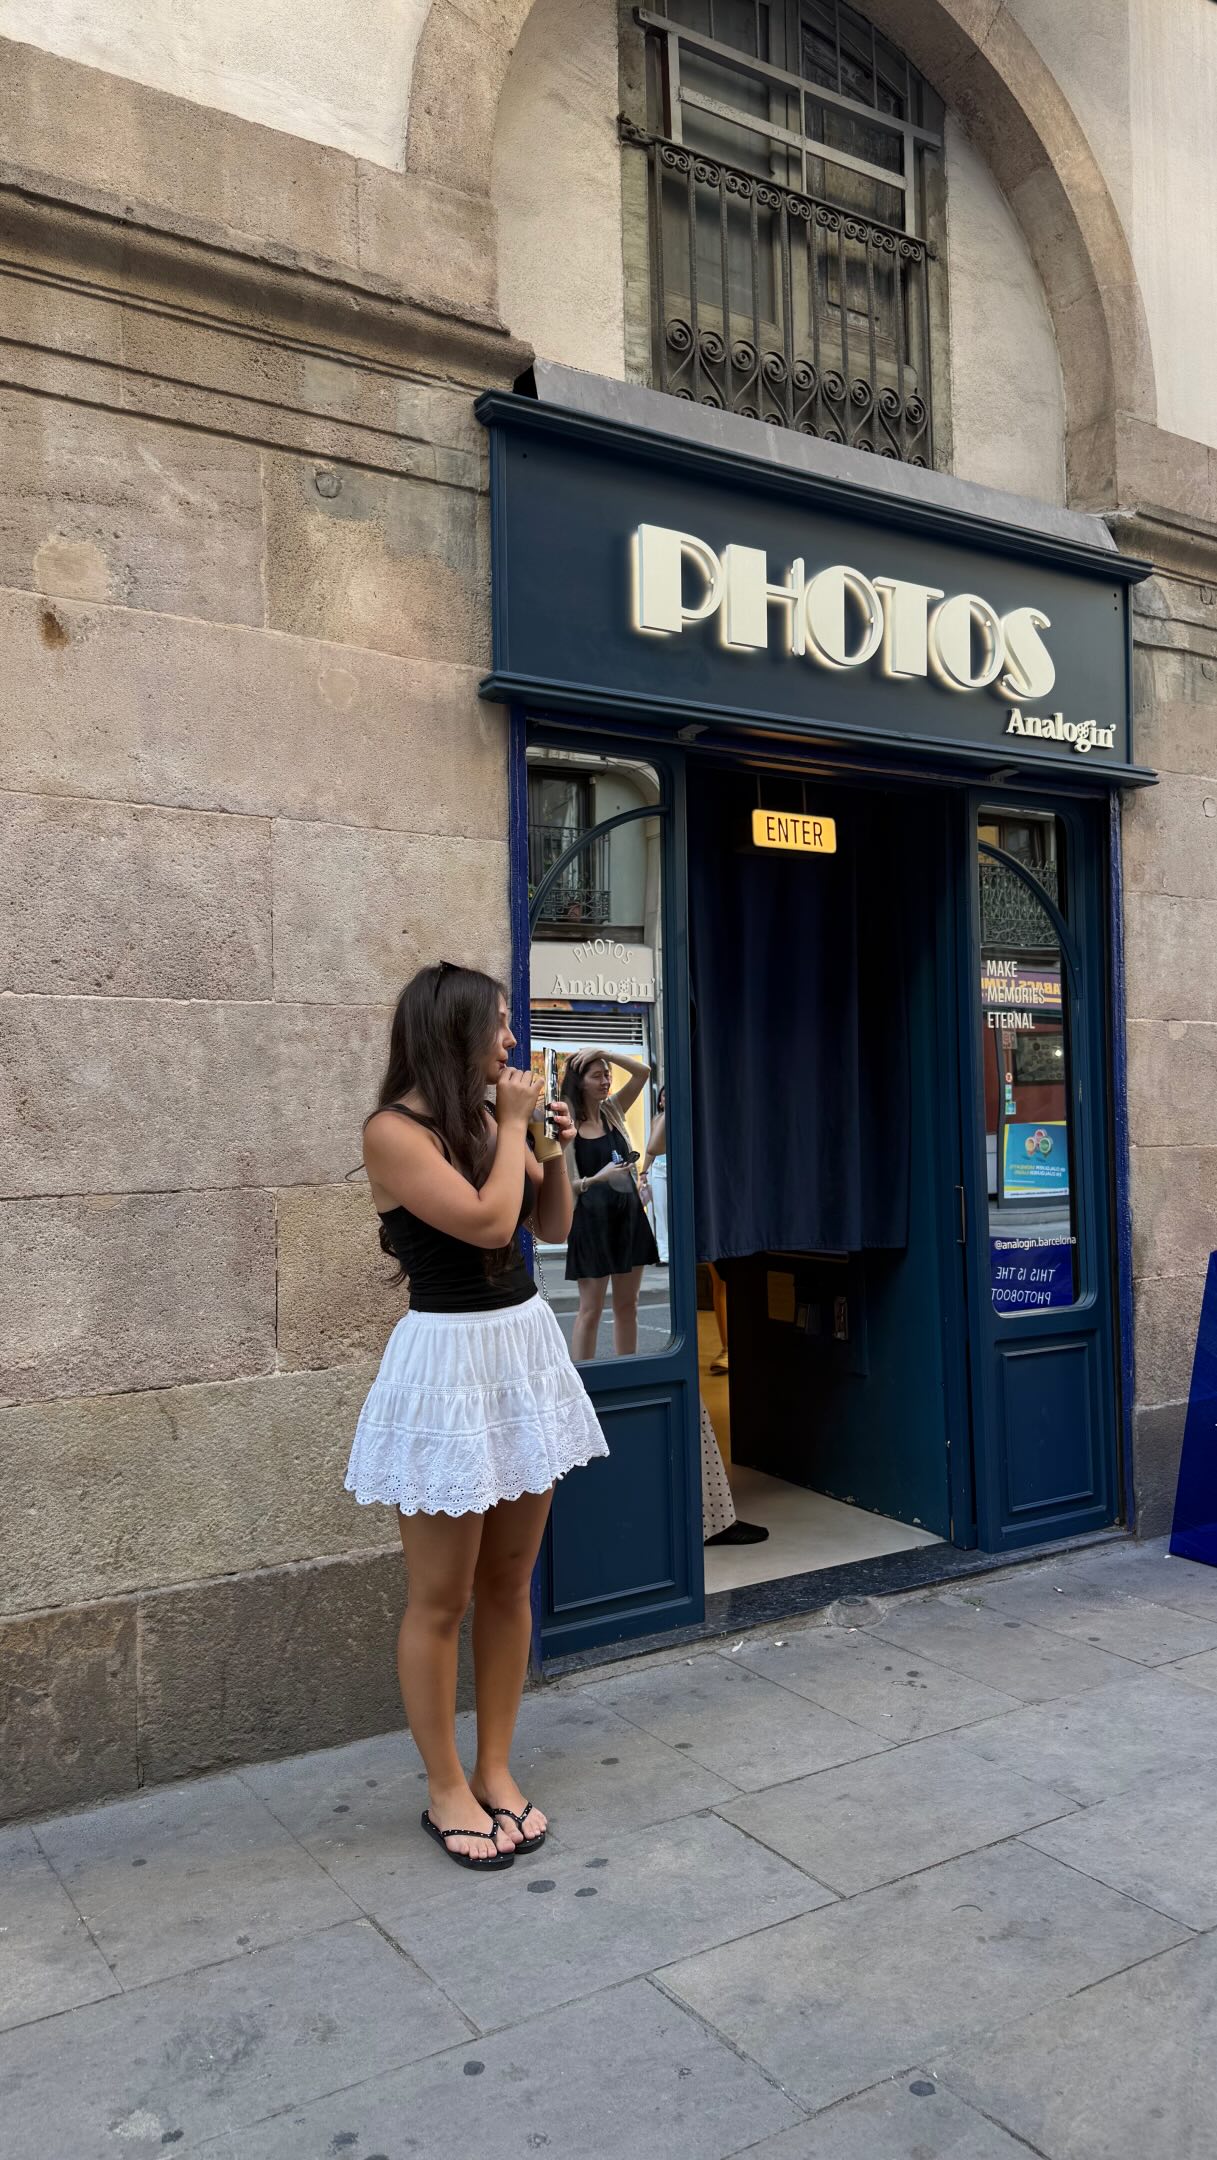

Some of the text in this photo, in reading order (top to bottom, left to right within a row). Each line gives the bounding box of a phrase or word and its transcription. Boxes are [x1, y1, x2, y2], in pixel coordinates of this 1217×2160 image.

[636, 523, 1056, 700] PHOTOS
[1006, 708, 1117, 753] Analogin'
[766, 816, 823, 847] ENTER
[572, 938, 634, 965] PHOTOS
[986, 960, 1018, 977] MAKE
[987, 986, 1045, 1004] MEMORIES
[987, 1011, 1036, 1029] ETERNAL
[994, 1235, 1077, 1250] @analogin.barcelona
